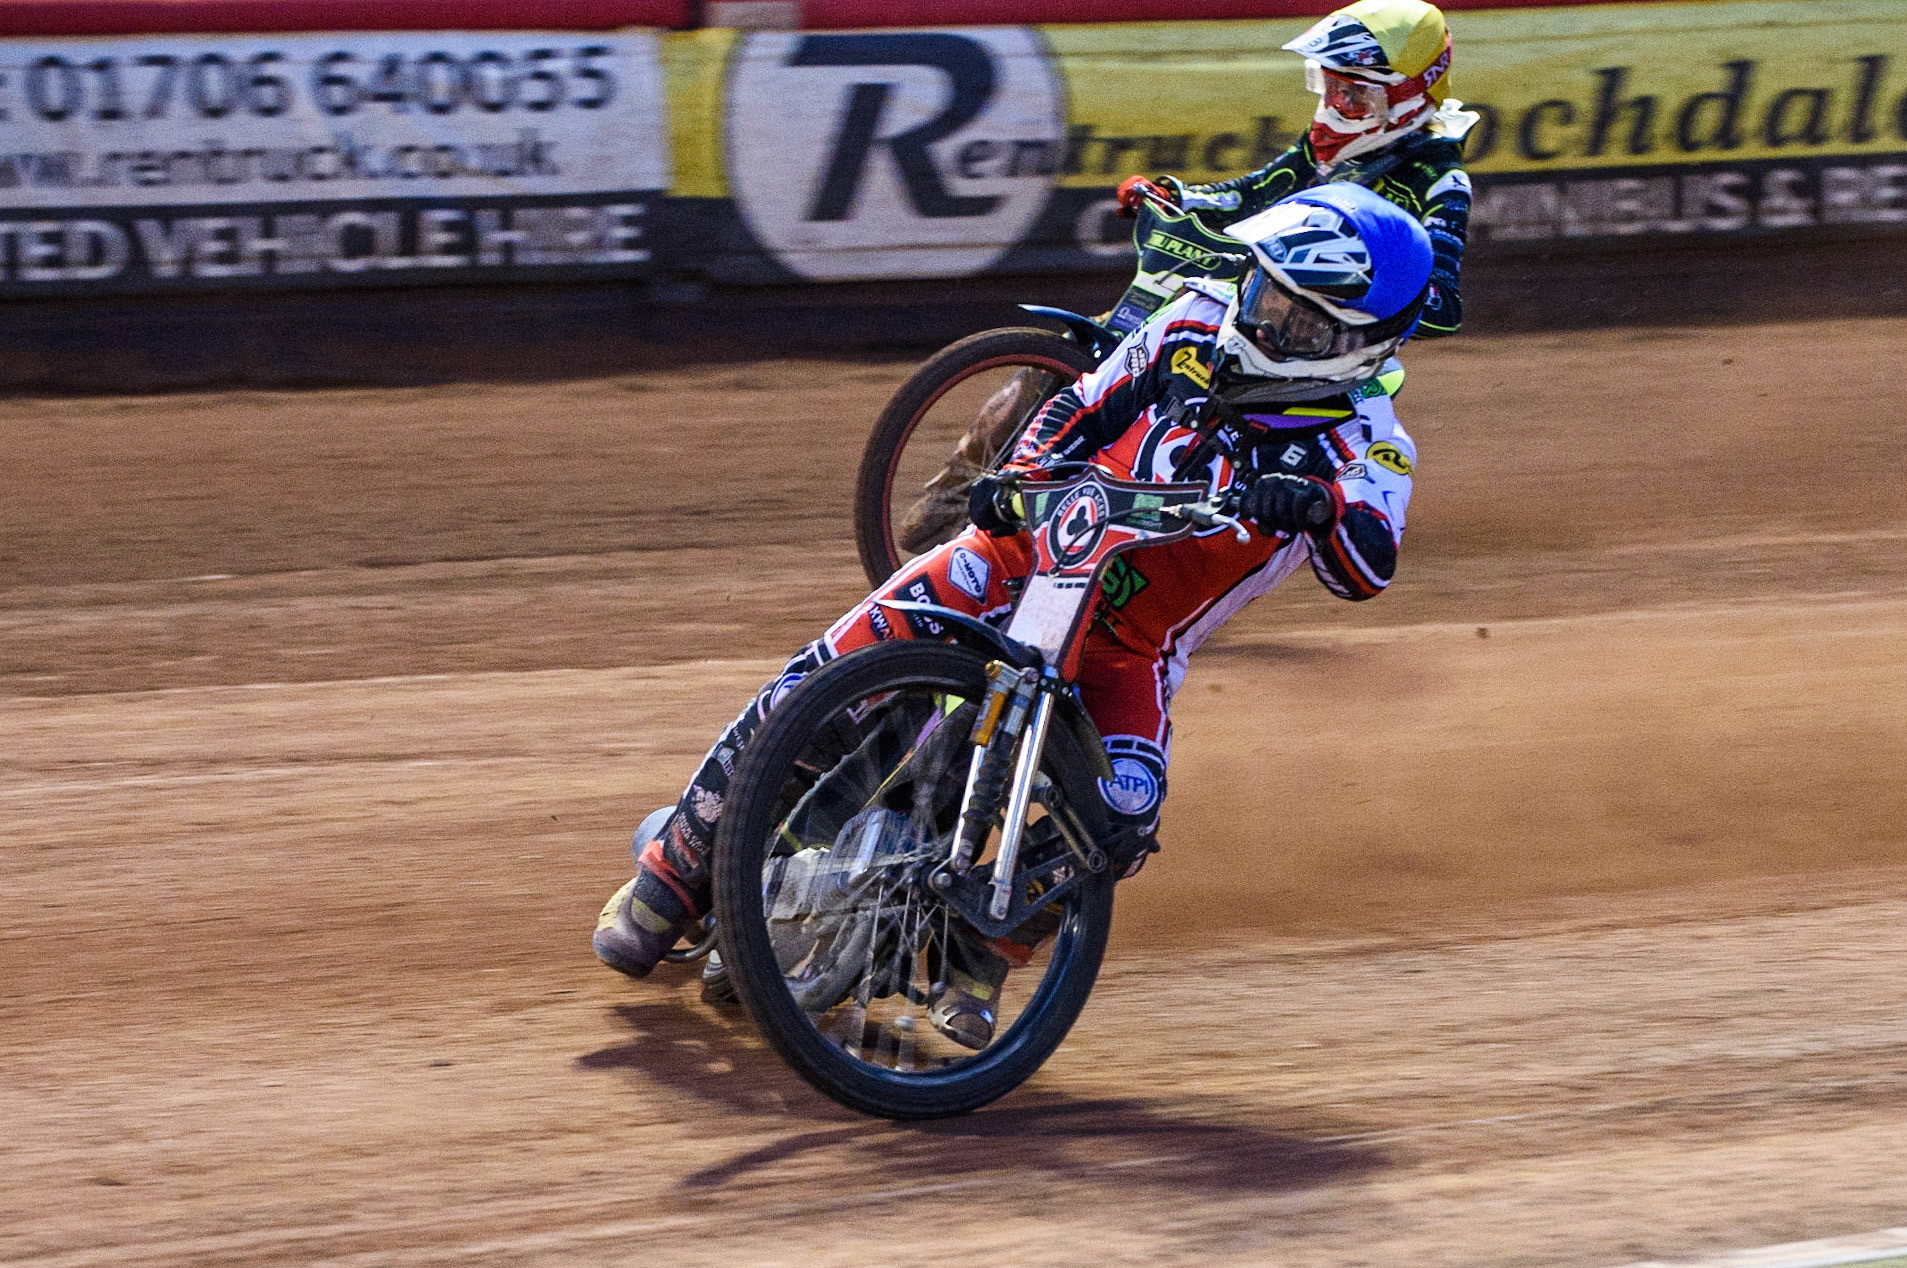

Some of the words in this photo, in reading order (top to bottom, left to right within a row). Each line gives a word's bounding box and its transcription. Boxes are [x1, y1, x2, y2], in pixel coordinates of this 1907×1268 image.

[26, 50, 292, 121] 01706
[313, 46, 616, 117] 640055
[1462, 52, 1907, 165] ochdal
[136, 208, 467, 278] VEHICLE
[477, 202, 650, 267] HIRE
[1108, 774, 1149, 795] ATPI
